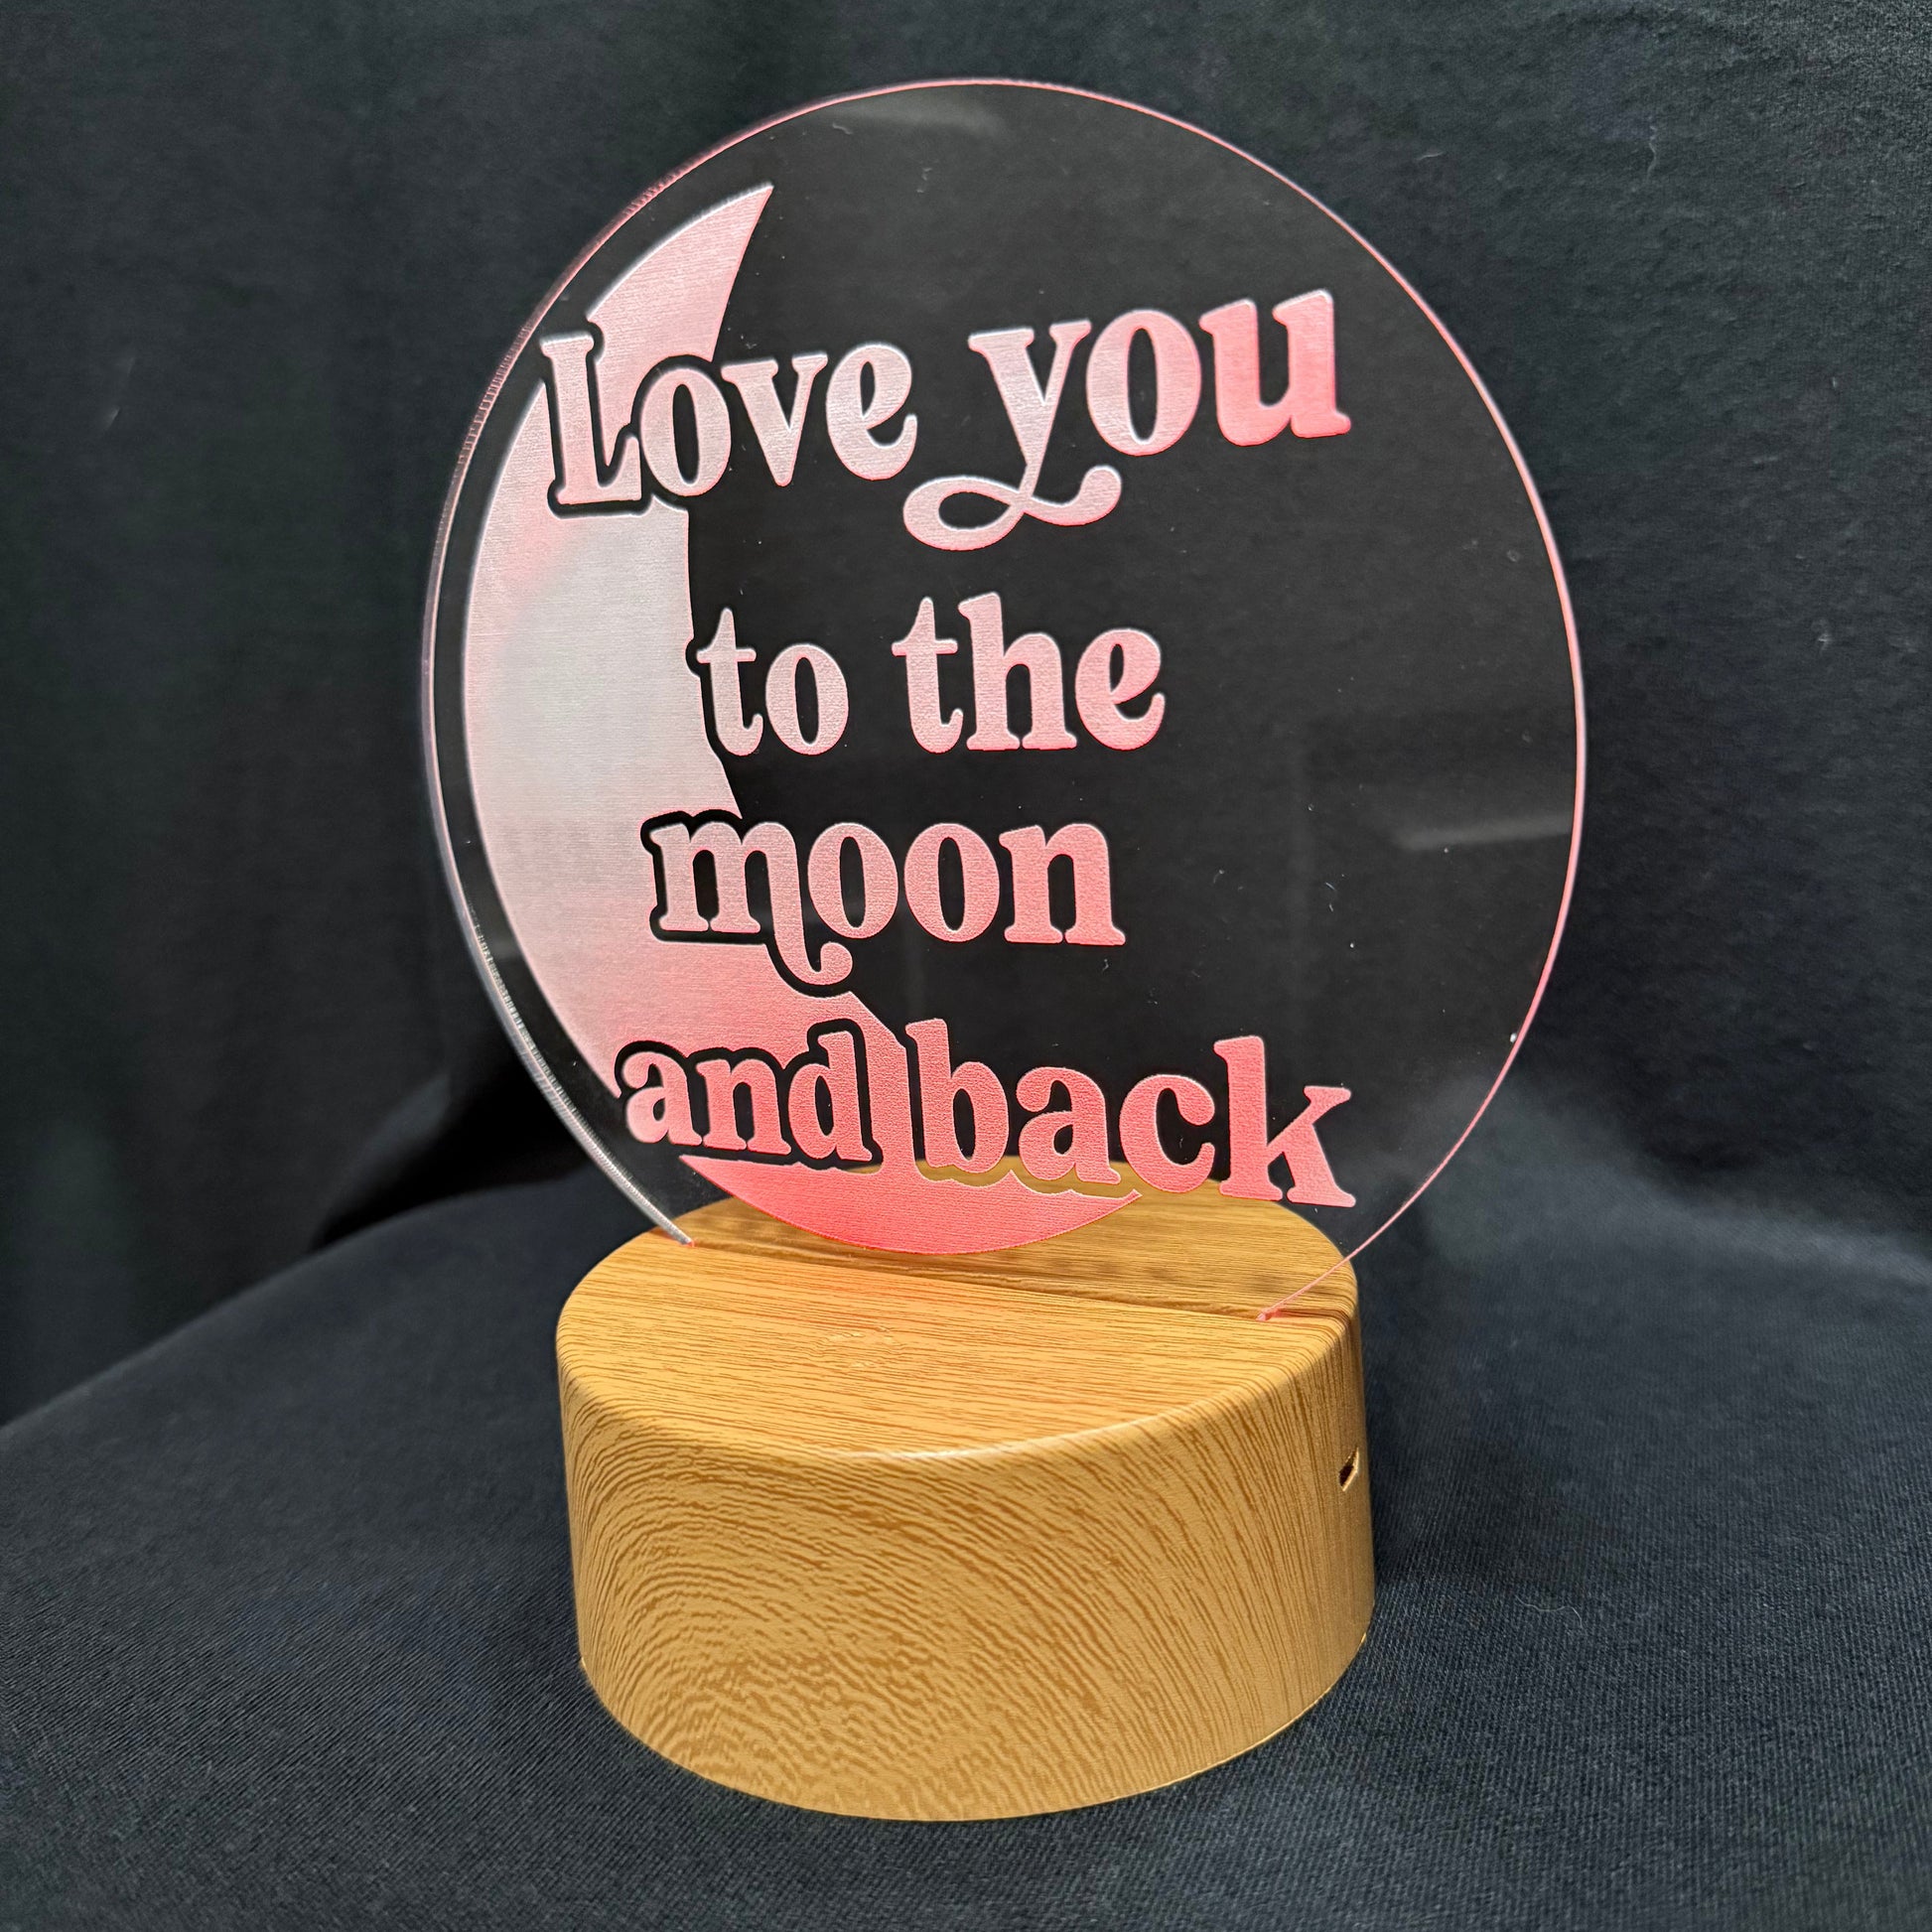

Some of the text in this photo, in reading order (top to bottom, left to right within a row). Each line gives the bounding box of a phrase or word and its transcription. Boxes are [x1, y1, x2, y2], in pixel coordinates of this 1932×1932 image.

[541, 290, 1351, 551] Love you
[697, 592, 1166, 756] to the
[649, 821, 1126, 985] moon
[624, 1018, 1356, 1207] and back
